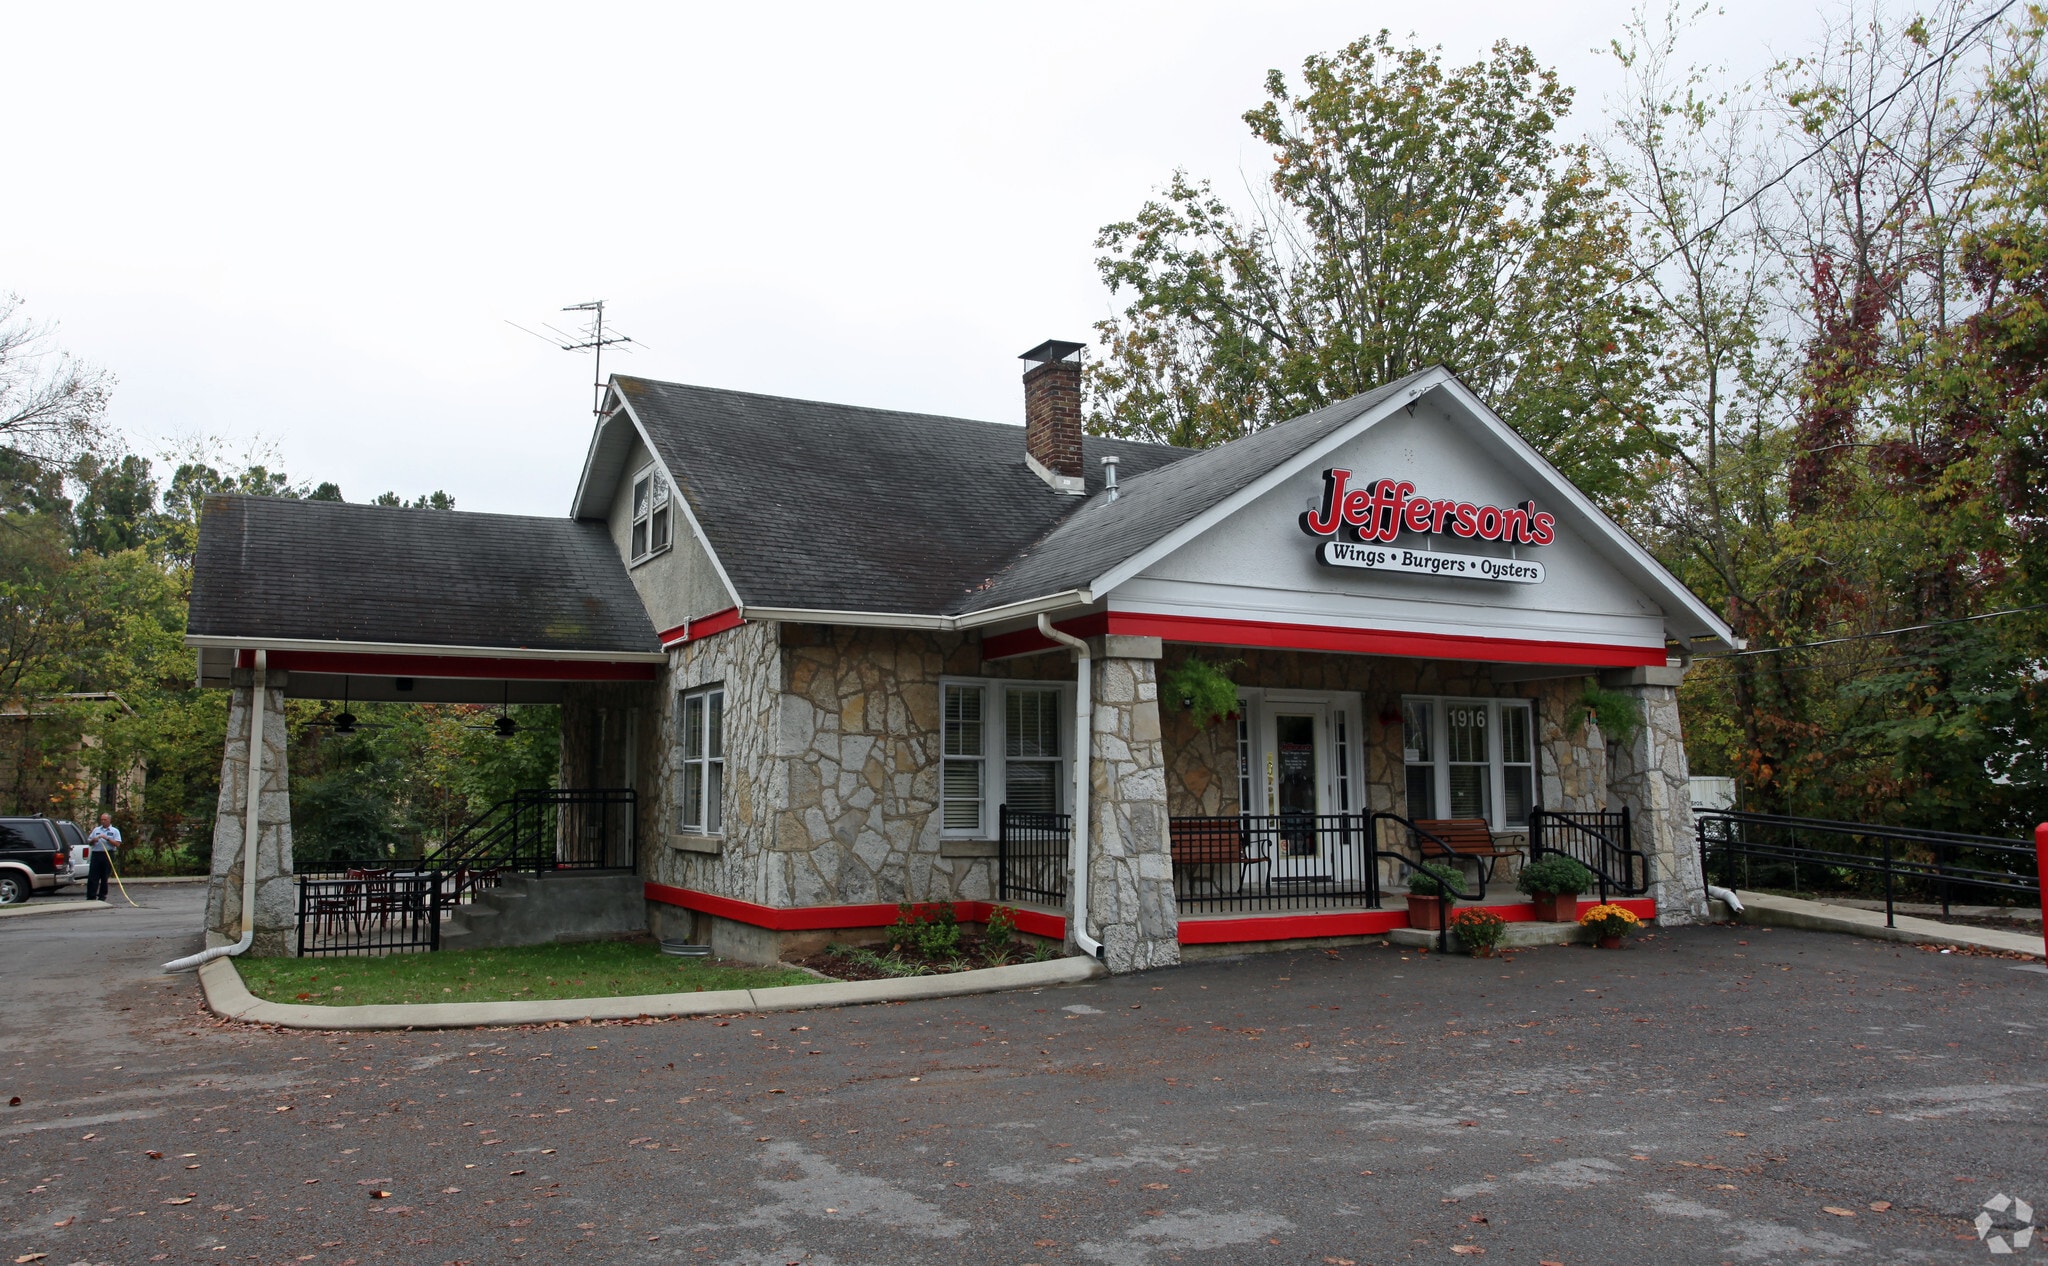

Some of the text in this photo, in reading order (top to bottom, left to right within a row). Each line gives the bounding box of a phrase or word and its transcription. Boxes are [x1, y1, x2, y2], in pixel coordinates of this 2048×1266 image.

[1307, 468, 1555, 545] Jefferson's
[1333, 543, 1538, 579] Wings Burgers Oysters
[1449, 709, 1486, 728] 1916
